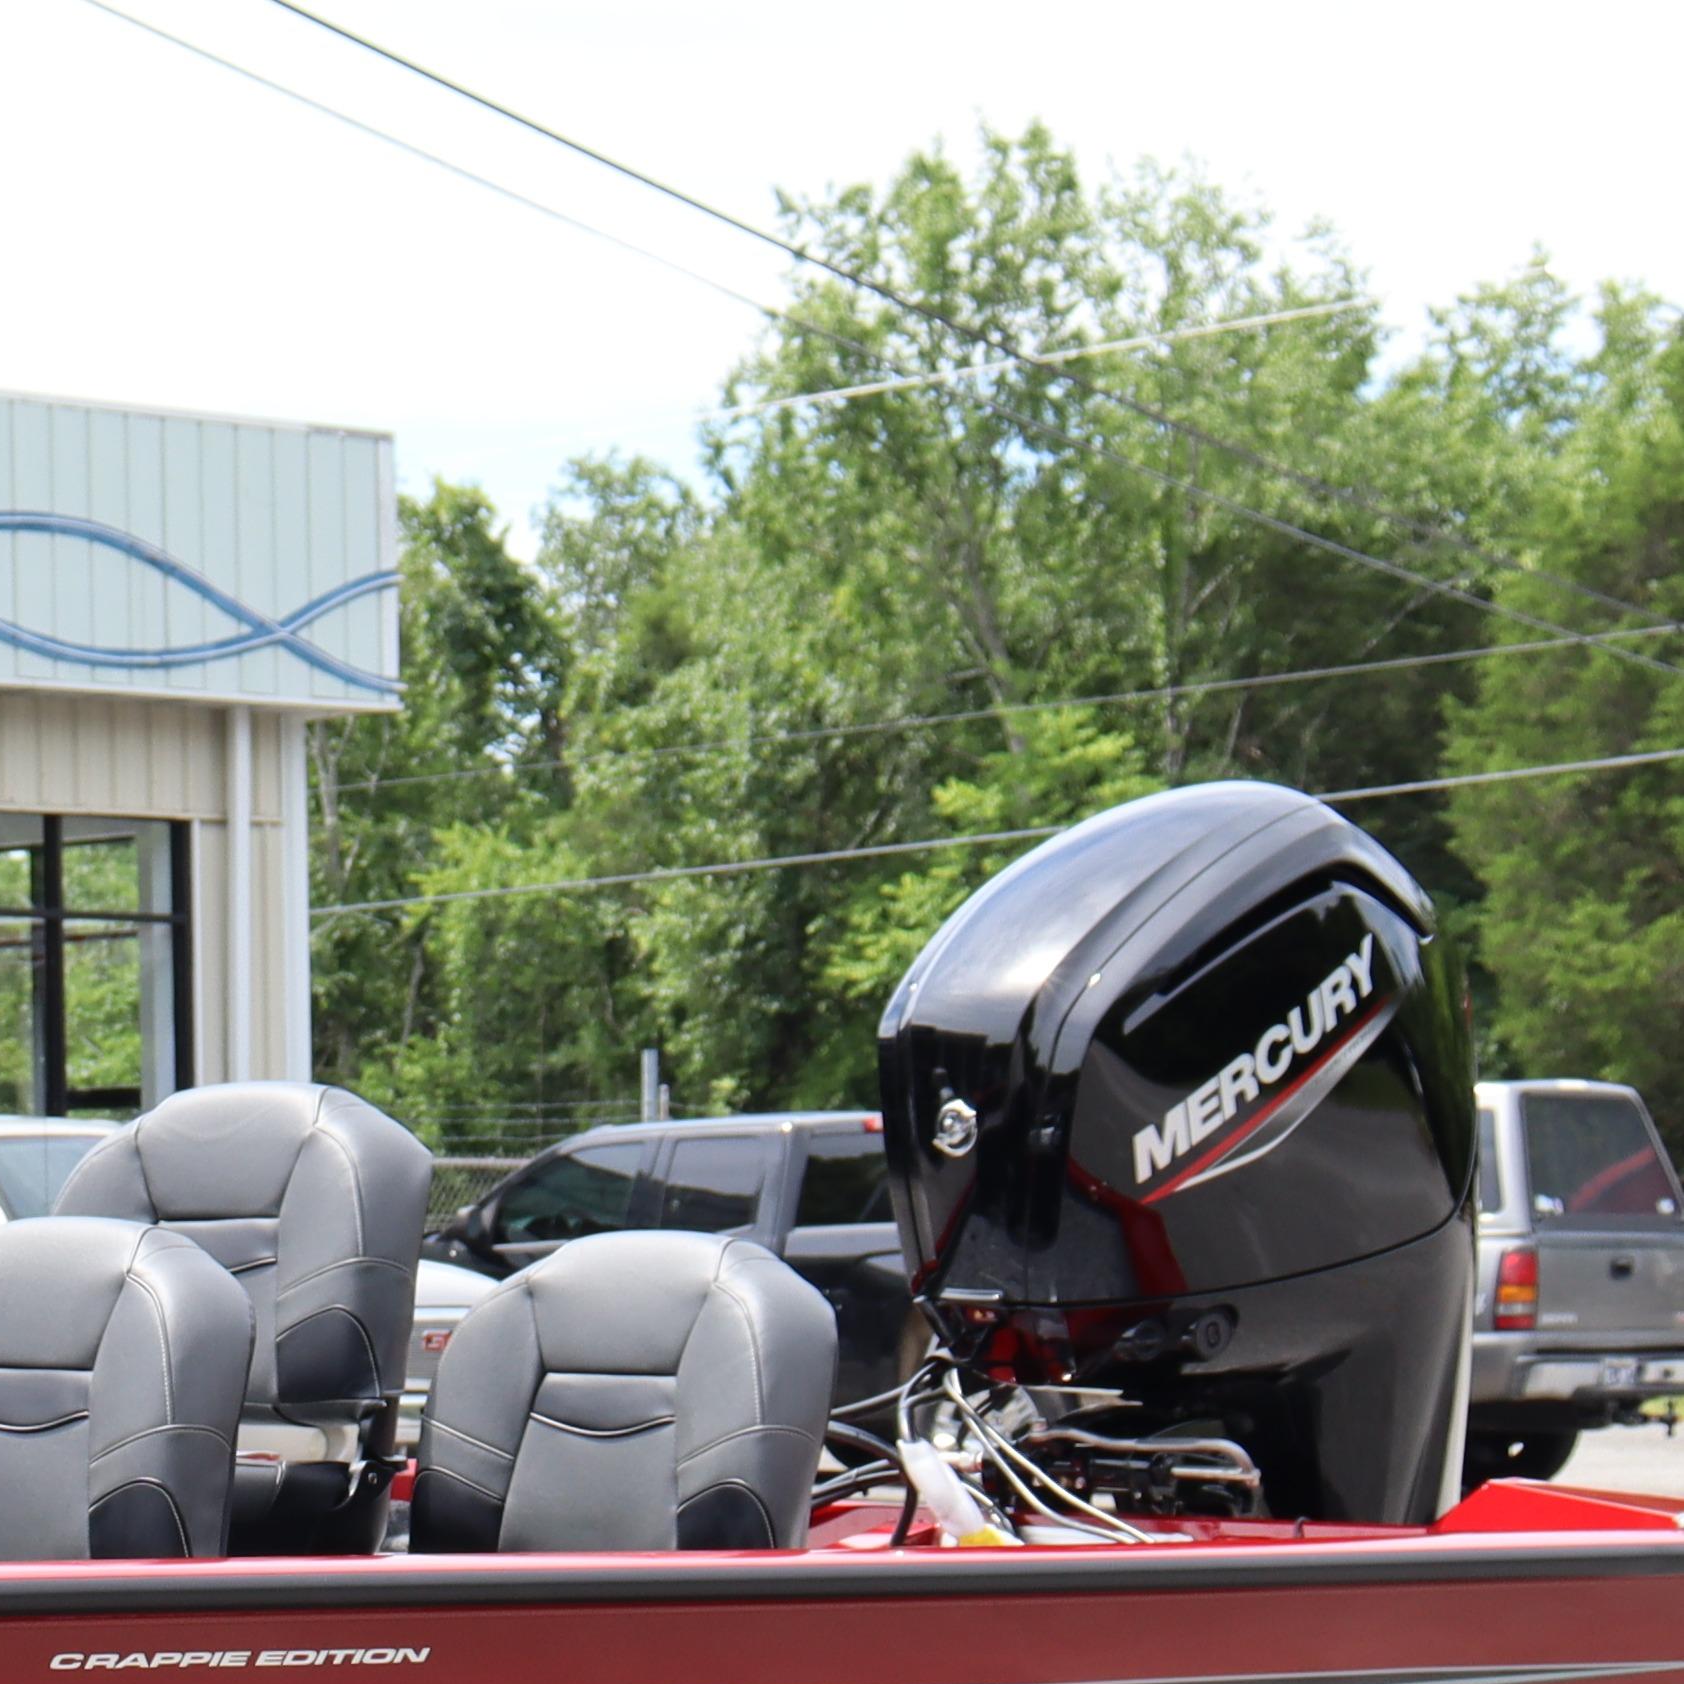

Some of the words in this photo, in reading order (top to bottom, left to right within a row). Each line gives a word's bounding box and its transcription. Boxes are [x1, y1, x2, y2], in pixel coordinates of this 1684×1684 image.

[1133, 933, 1373, 1184] MERCURY
[49, 1650, 252, 1671] CRAPPIE
[254, 1646, 432, 1668] EDITION
